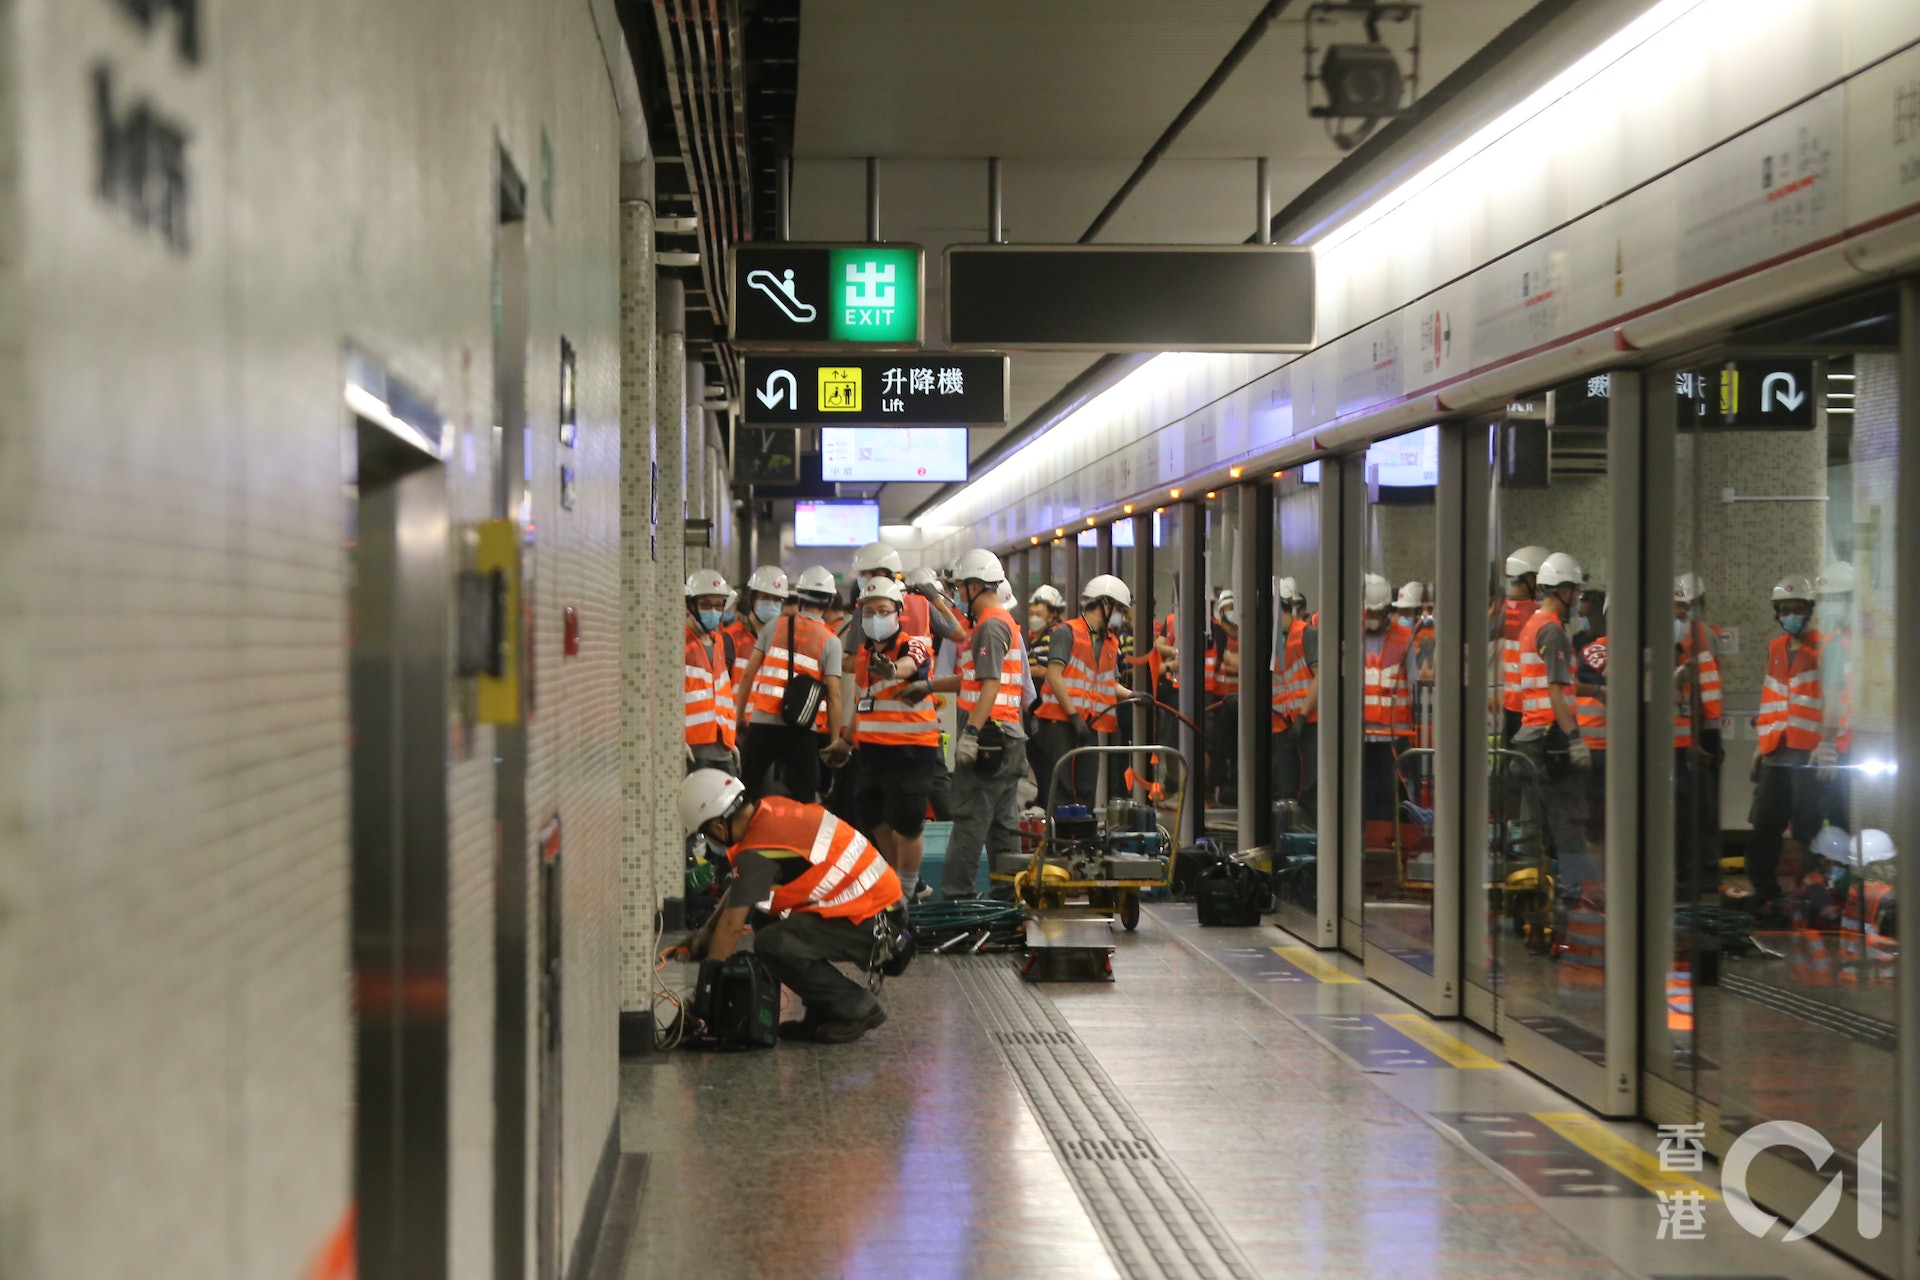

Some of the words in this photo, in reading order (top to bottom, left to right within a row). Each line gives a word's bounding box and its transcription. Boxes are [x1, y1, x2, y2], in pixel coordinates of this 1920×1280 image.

[845, 309, 896, 325] EXIT
[881, 367, 964, 395] 升降機
[882, 398, 904, 412] Lift
